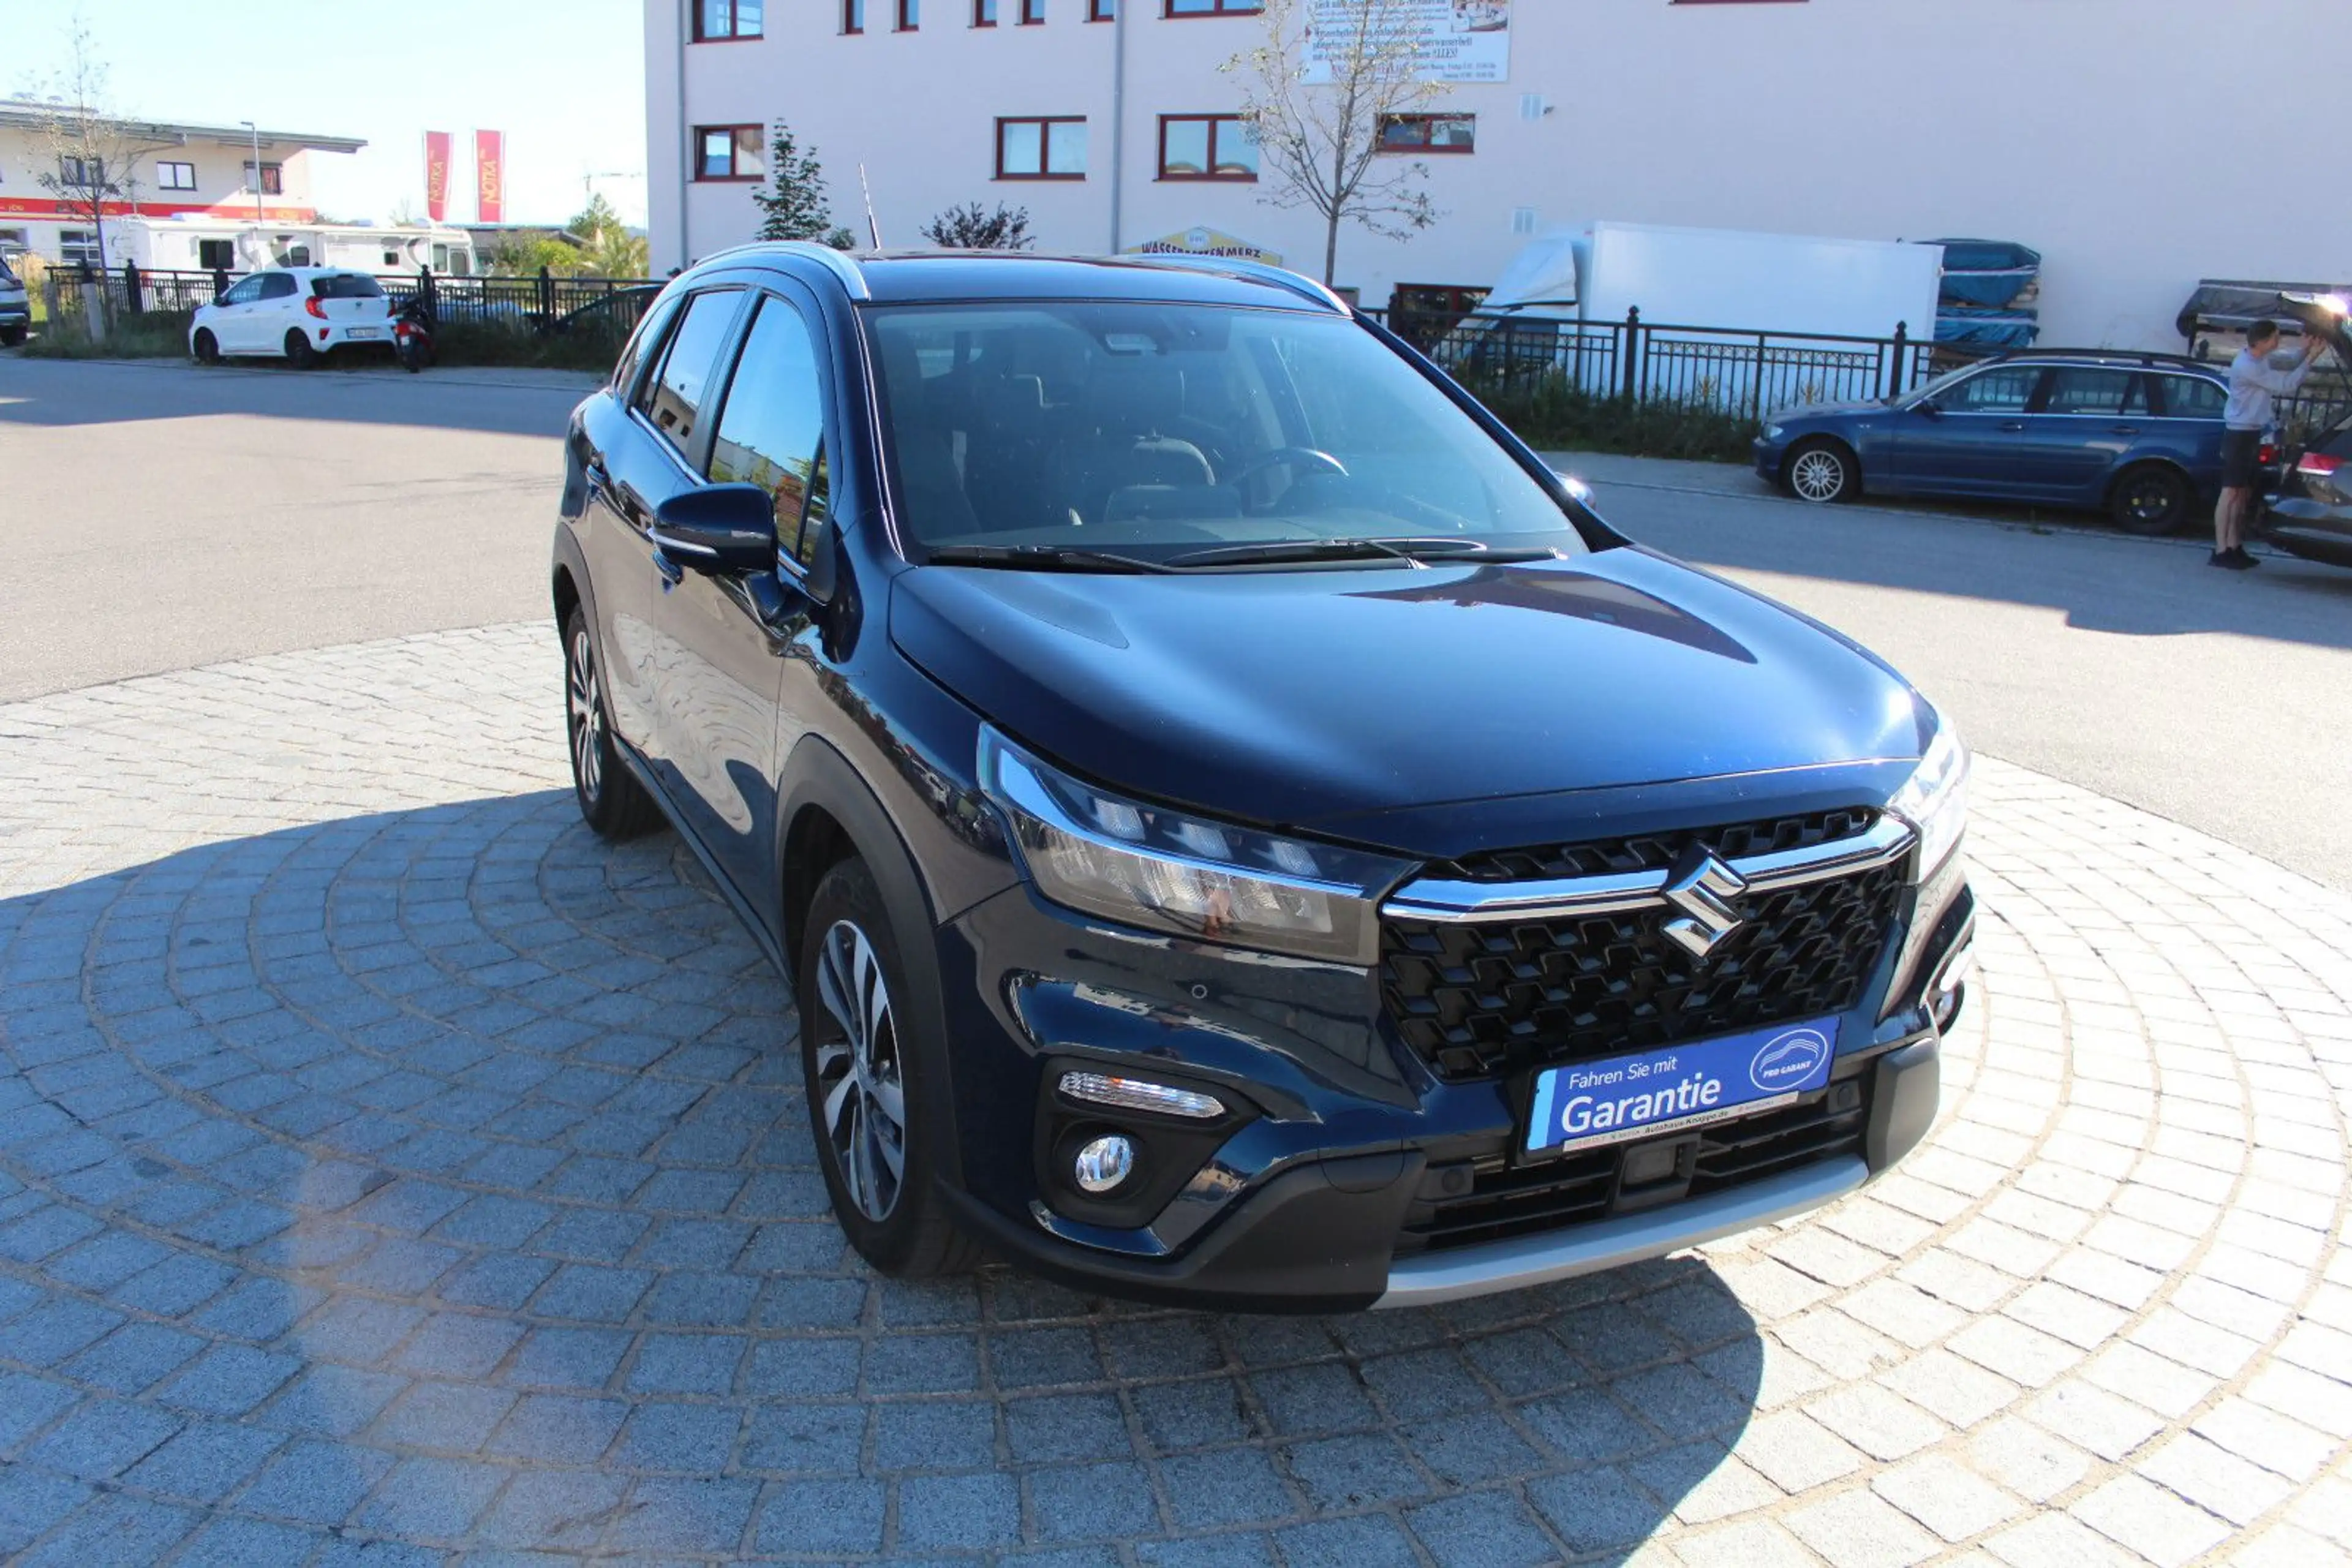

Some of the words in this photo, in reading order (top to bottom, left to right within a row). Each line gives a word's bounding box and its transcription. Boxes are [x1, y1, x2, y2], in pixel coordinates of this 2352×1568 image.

[482, 160, 500, 203] NOTKA
[1226, 247, 1261, 258] MERZ
[1569, 1070, 1623, 1090] Fahren
[1627, 1063, 1650, 1080] Sie
[1654, 1057, 1678, 1074] mit
[1763, 1068, 1779, 1078] PRO
[1780, 1060, 1812, 1074] GARANT
[1562, 1073, 1721, 1133] Garantie
